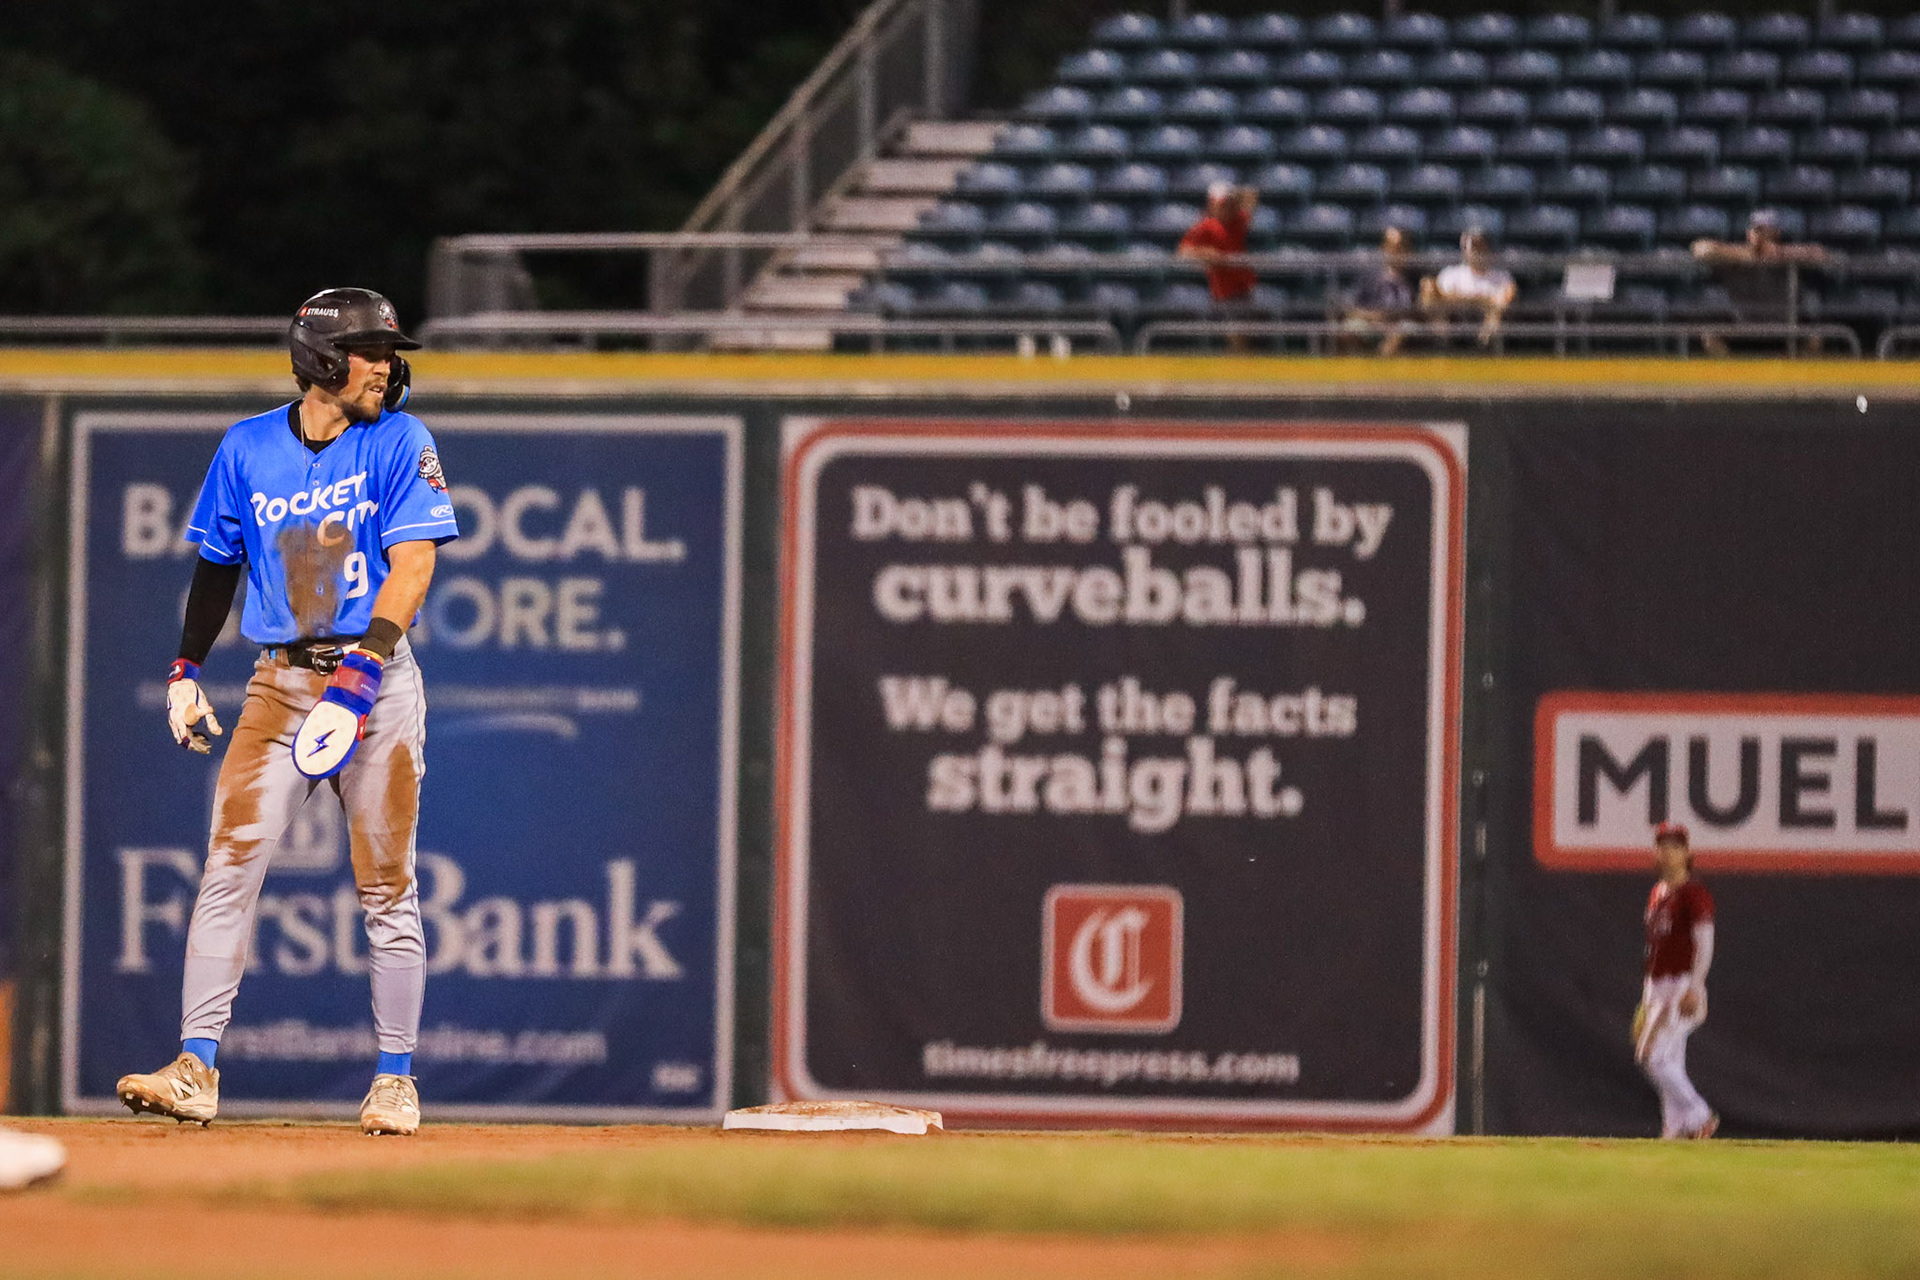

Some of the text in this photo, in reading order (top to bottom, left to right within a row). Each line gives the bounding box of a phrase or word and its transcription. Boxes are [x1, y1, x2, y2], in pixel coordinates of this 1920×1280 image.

[251, 471, 367, 527] ROCKET
[317, 500, 379, 547] CITY
[440, 484, 687, 563] OCAL.
[850, 484, 1394, 559] Don't be fooled by
[344, 551, 369, 600] 9
[873, 546, 1367, 626] curveballs.
[408, 576, 627, 653] ORE.
[878, 676, 1359, 744] We get the facts
[926, 736, 1304, 834] straight.
[1577, 733, 1909, 831] MUEL
[114, 845, 683, 981] FrstBank
[1069, 904, 1154, 1013] C
[923, 1039, 1301, 1086] timesfreepress.com
